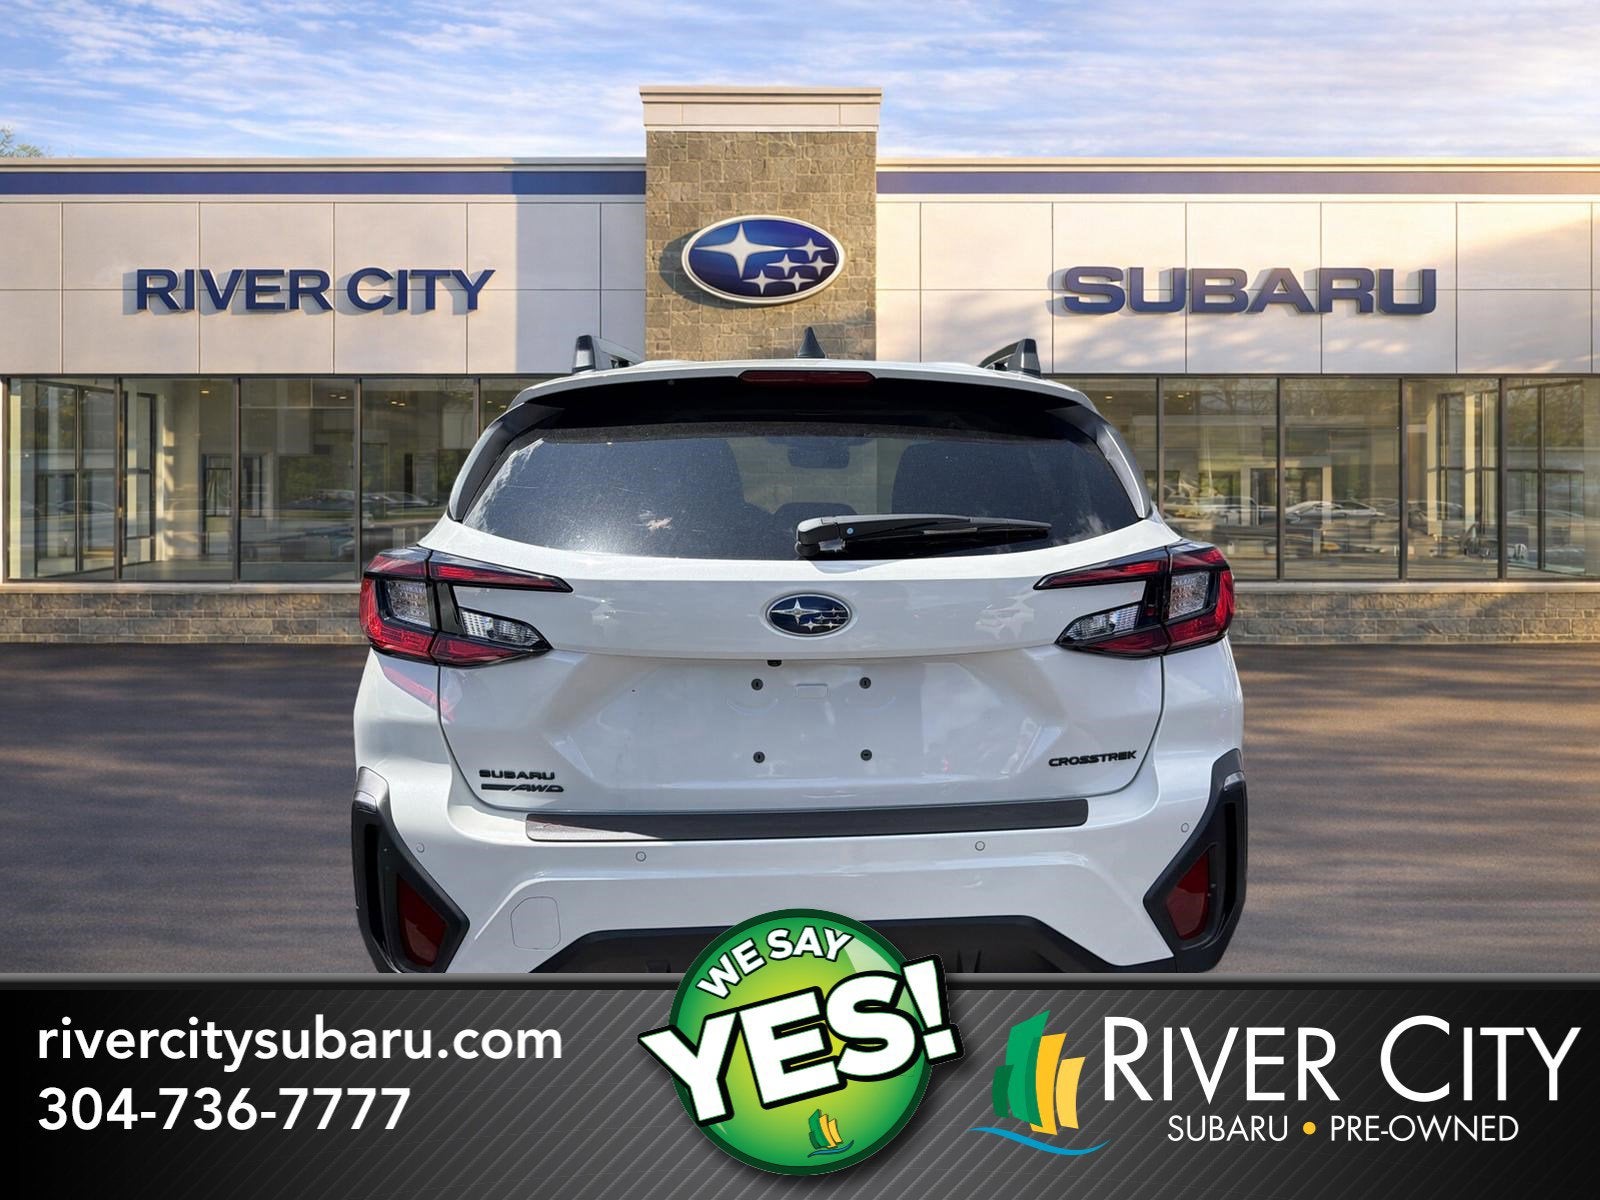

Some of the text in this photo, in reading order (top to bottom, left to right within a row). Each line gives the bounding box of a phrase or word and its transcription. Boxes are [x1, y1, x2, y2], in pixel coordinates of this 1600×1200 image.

[136, 267, 496, 312] RIVER CITY
[1062, 266, 1437, 315] SUBARU
[1048, 750, 1137, 767] CROSSTREK
[479, 769, 555, 780] SUBARU
[511, 784, 564, 793] AWD
